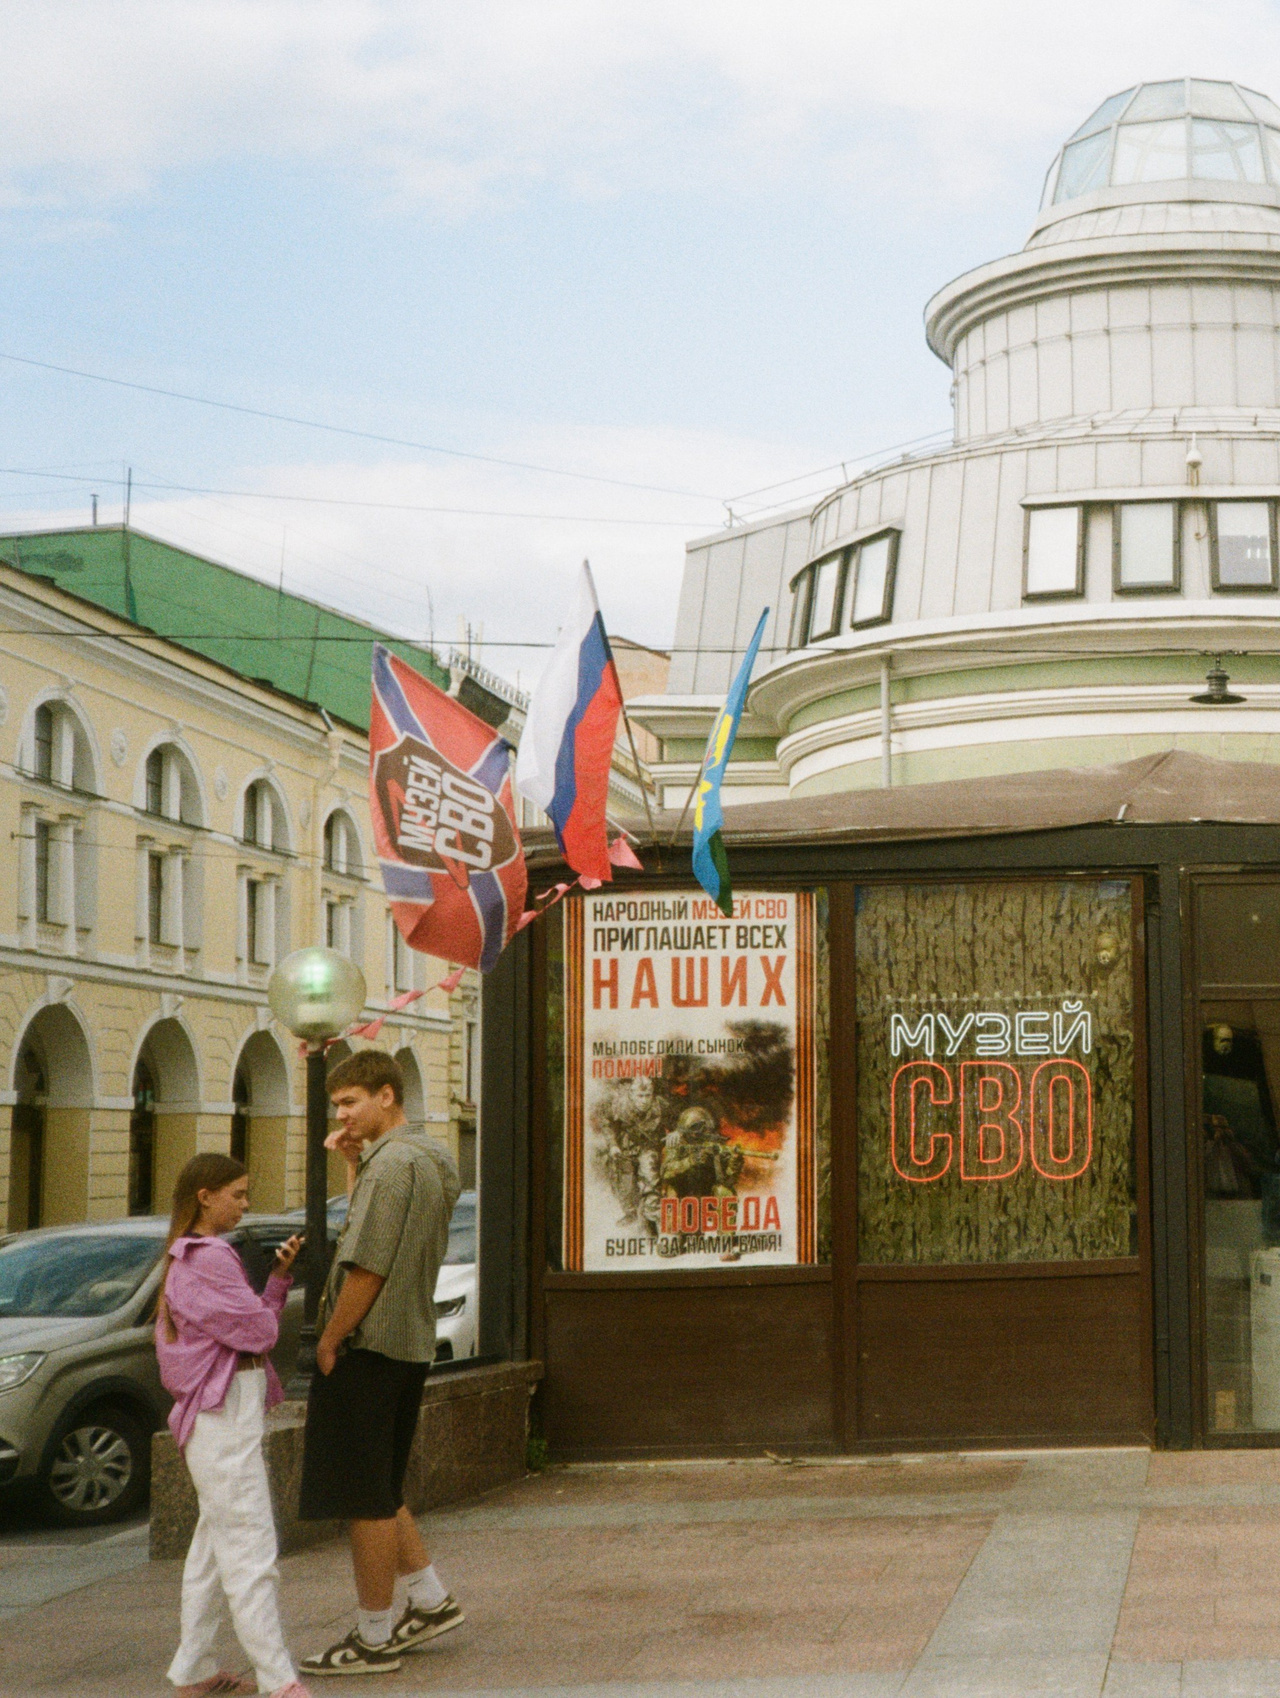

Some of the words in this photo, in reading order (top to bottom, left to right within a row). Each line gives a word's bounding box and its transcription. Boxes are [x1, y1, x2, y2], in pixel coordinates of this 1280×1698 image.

[397, 755, 442, 852] МУЗЕЙ
[434, 771, 494, 869] СВО
[593, 895, 687, 921] НАРОДНЫЙ
[755, 899, 787, 920] СВО
[593, 925, 730, 952] ПРИГЛАШАЕТ
[736, 924, 787, 949] ВСЕХ
[592, 955, 787, 1010] НАШИХ
[891, 1001, 1091, 1056] МУЗЕЙ
[592, 1041, 616, 1056] МЫ
[592, 1058, 663, 1079] ПОМНИ!
[891, 1059, 1092, 1182] СВО
[660, 1196, 781, 1233] ПОБЕДА
[606, 1237, 656, 1257] БУДЕТ
[660, 1237, 682, 1255] ЗА
[739, 1232, 782, 1253] БАТЯ!
